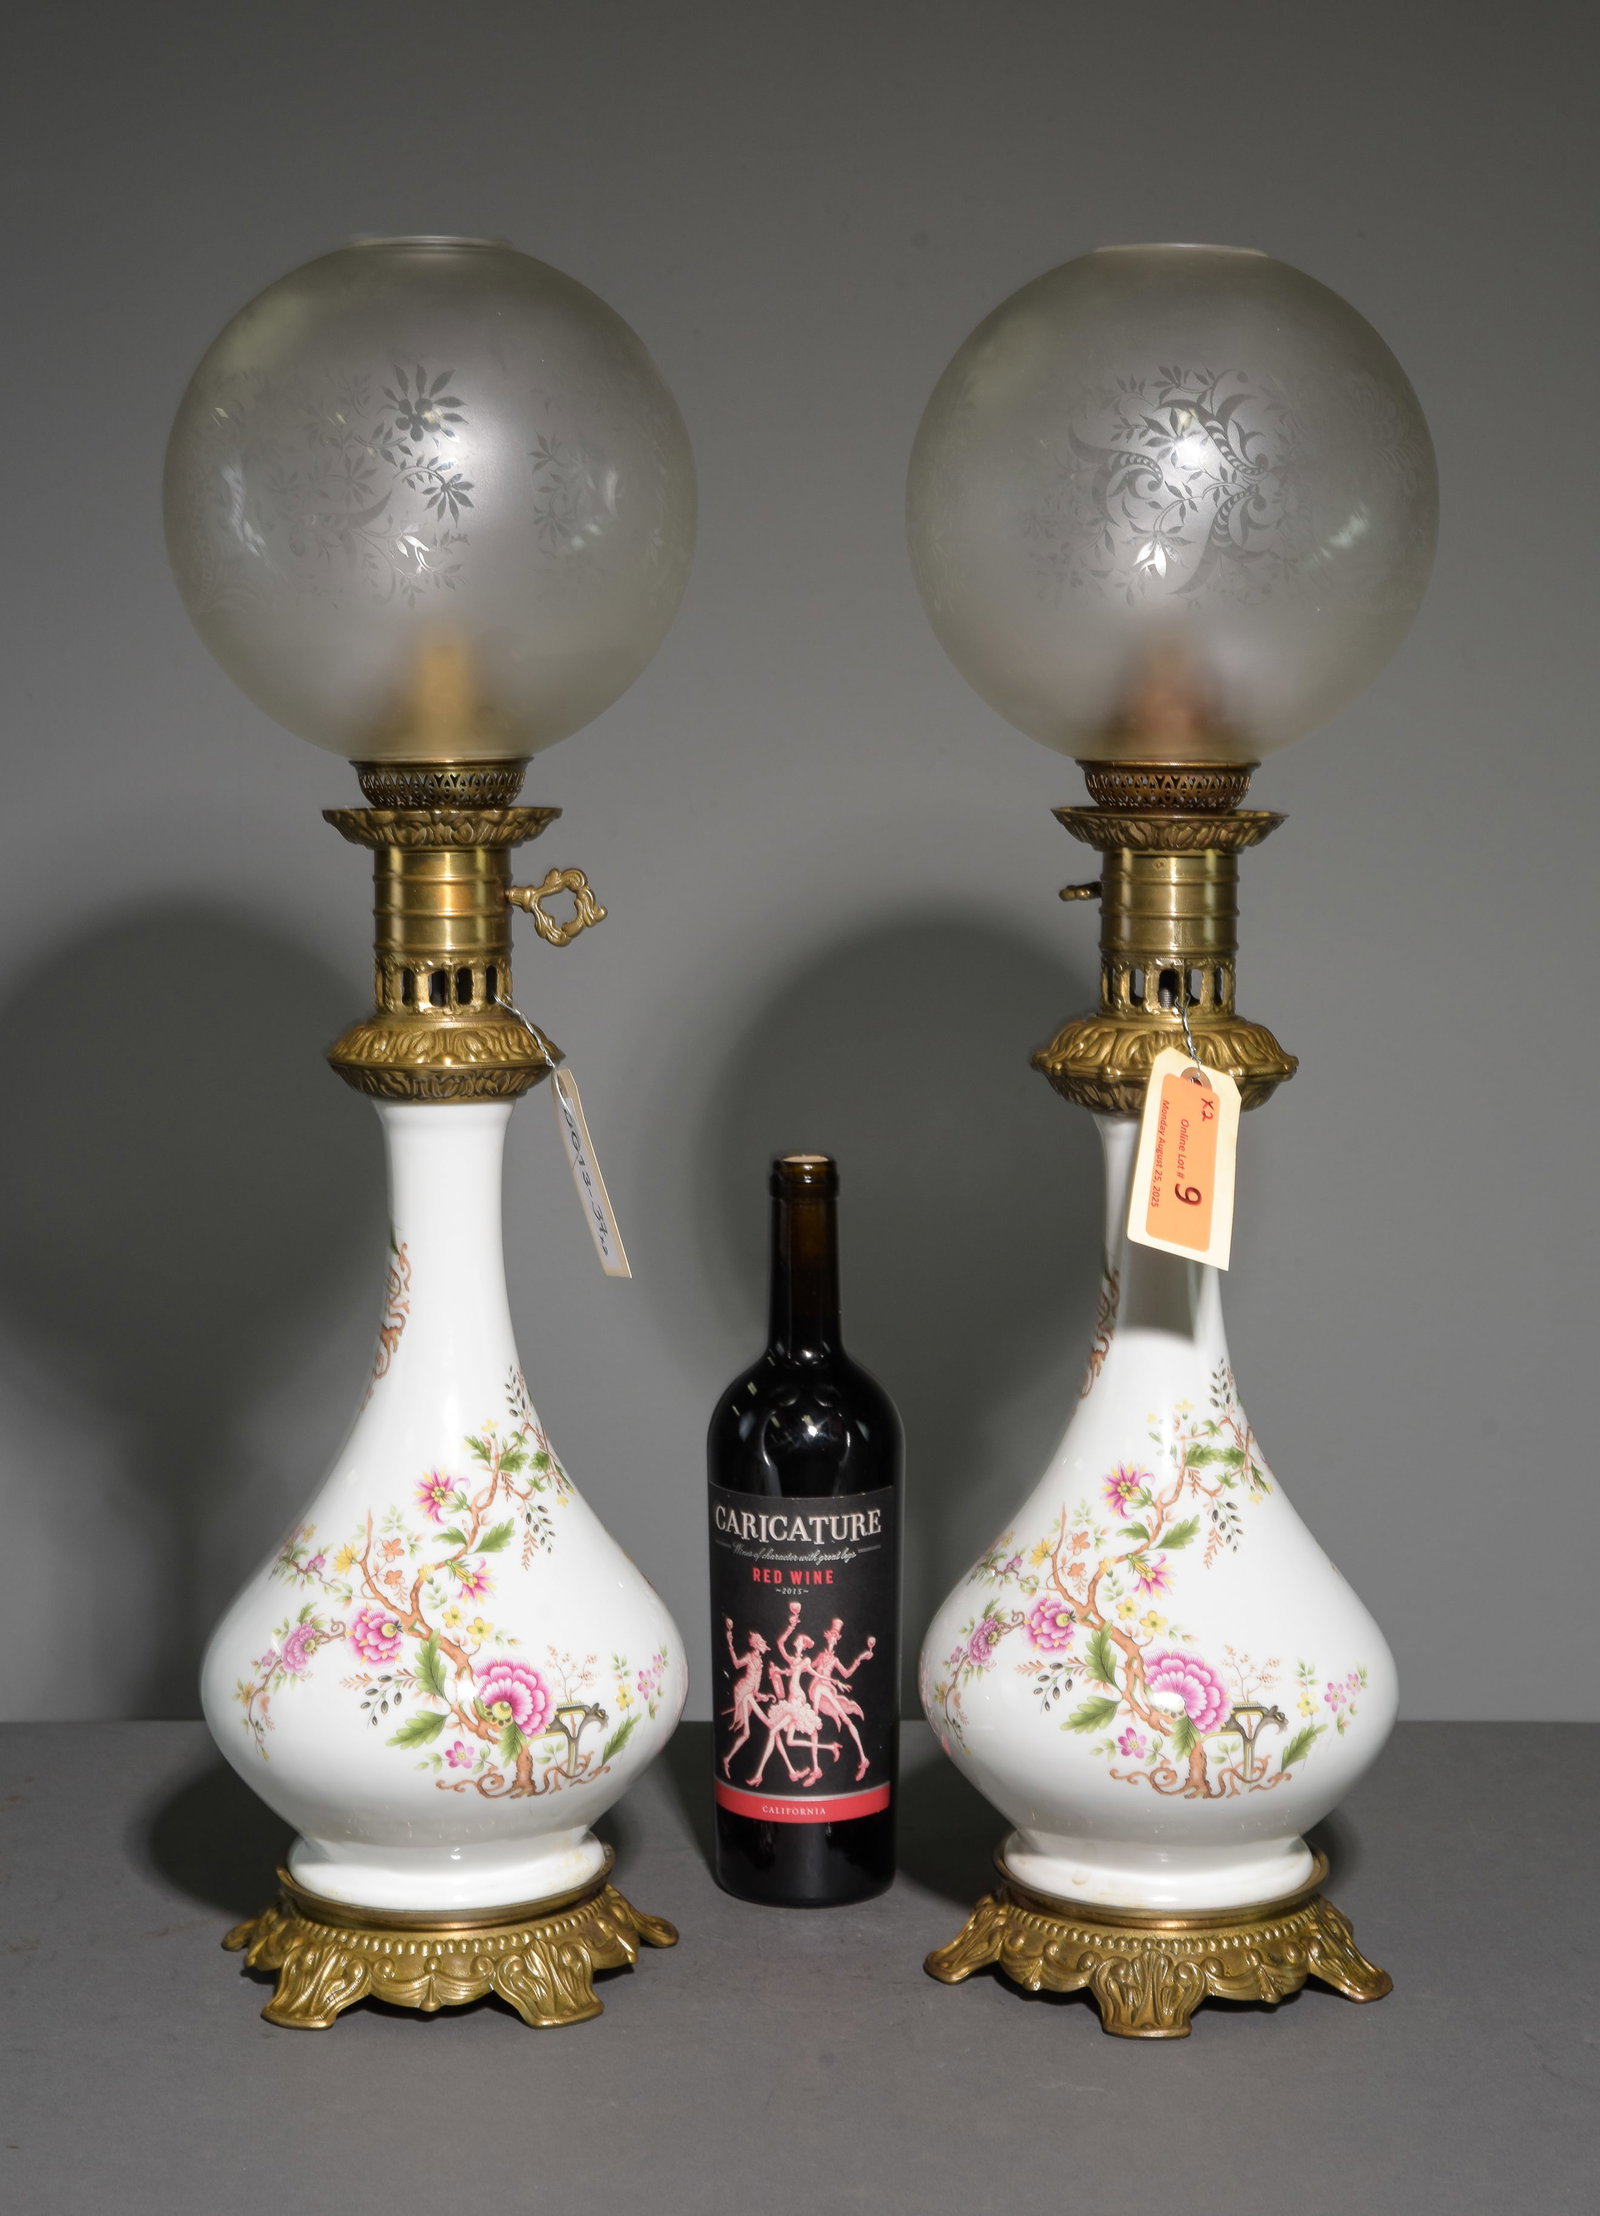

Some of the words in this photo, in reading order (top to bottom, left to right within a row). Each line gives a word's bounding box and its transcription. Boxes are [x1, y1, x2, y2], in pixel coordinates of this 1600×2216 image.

[1158, 1099, 1170, 1136] Monday
[1179, 1118, 1190, 1152] Online
[1155, 1136, 1166, 1168] August
[1177, 1152, 1187, 1173] Lot
[1154, 1169, 1164, 1183] 25,
[1151, 1184, 1161, 1208] 2025
[1174, 1183, 1203, 1207] 9
[715, 1505, 882, 1545] CARICATURE
[753, 1547, 766, 1562] of
[762, 1548, 798, 1562] character
[798, 1549, 820, 1562] with
[816, 1551, 842, 1565] great
[841, 1547, 857, 1563] legs
[753, 1567, 783, 1584] RED
[790, 1569, 835, 1586] WINE
[762, 1805, 826, 1816] CALIFORNIA
